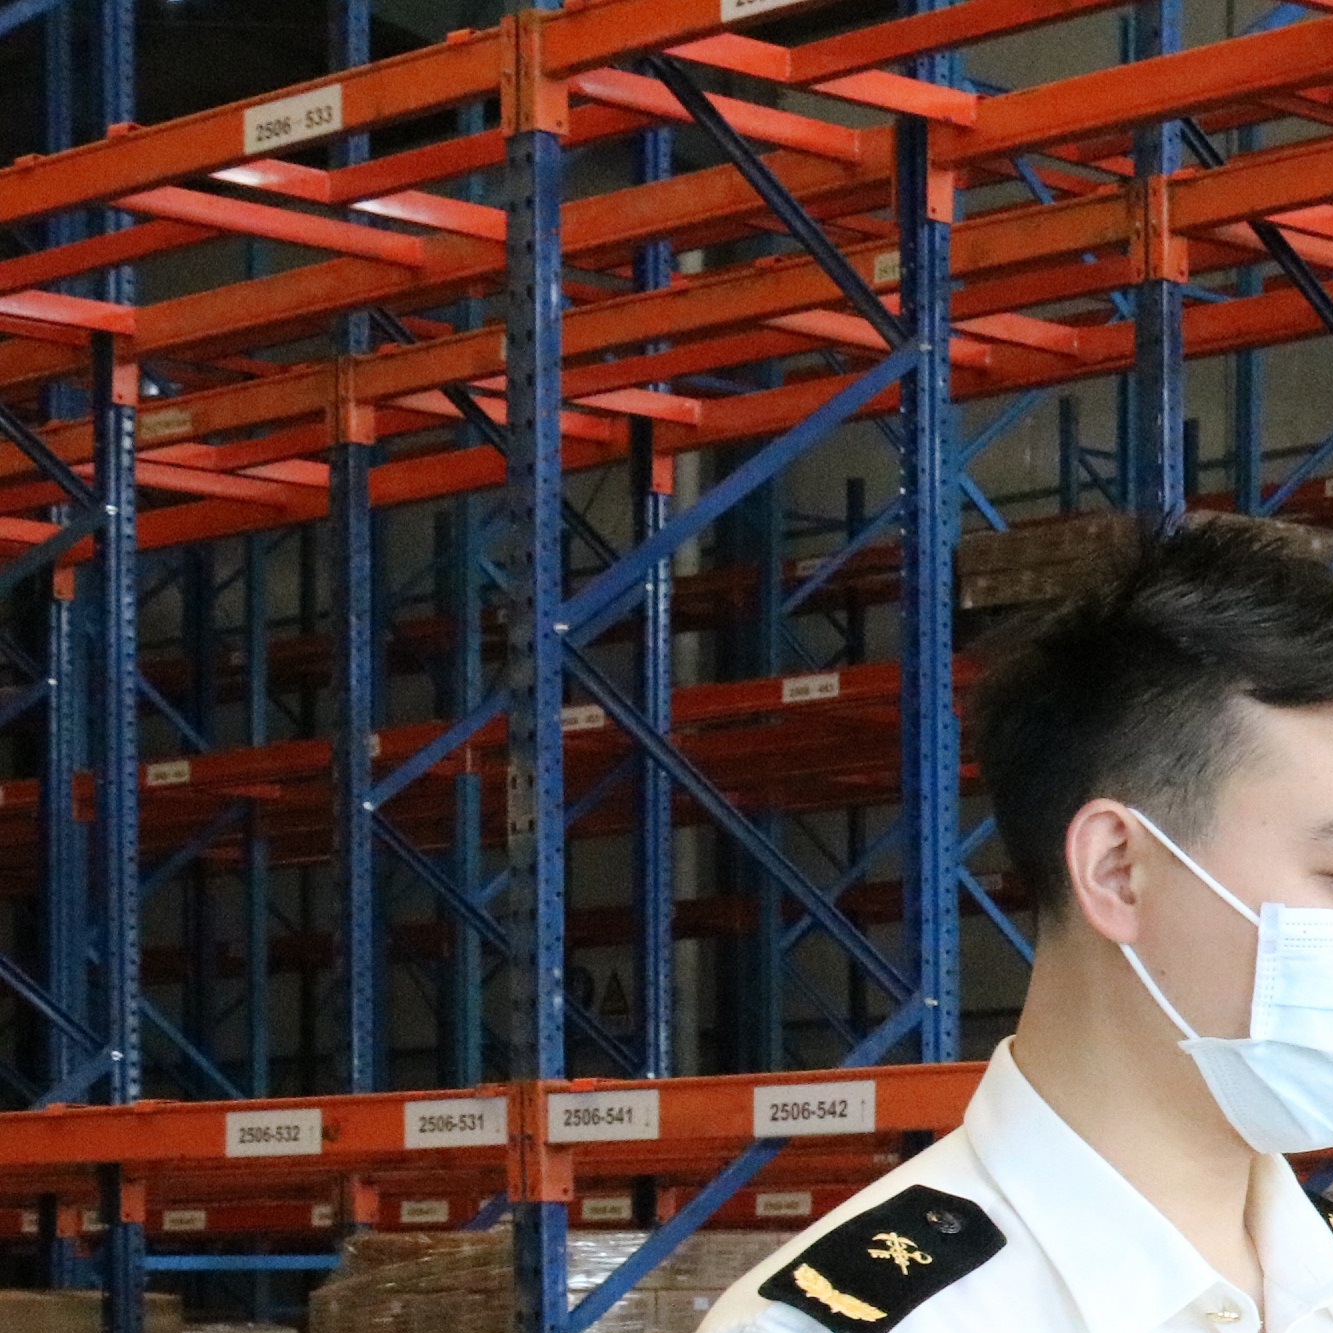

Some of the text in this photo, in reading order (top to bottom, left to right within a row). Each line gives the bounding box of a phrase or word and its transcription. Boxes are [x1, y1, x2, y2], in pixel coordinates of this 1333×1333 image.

[563, 1108, 633, 1127] 2506-541
[769, 1100, 848, 1121] 2506-542
[419, 1114, 485, 1133] 2506-531
[239, 1125, 301, 1144] 2506-532
